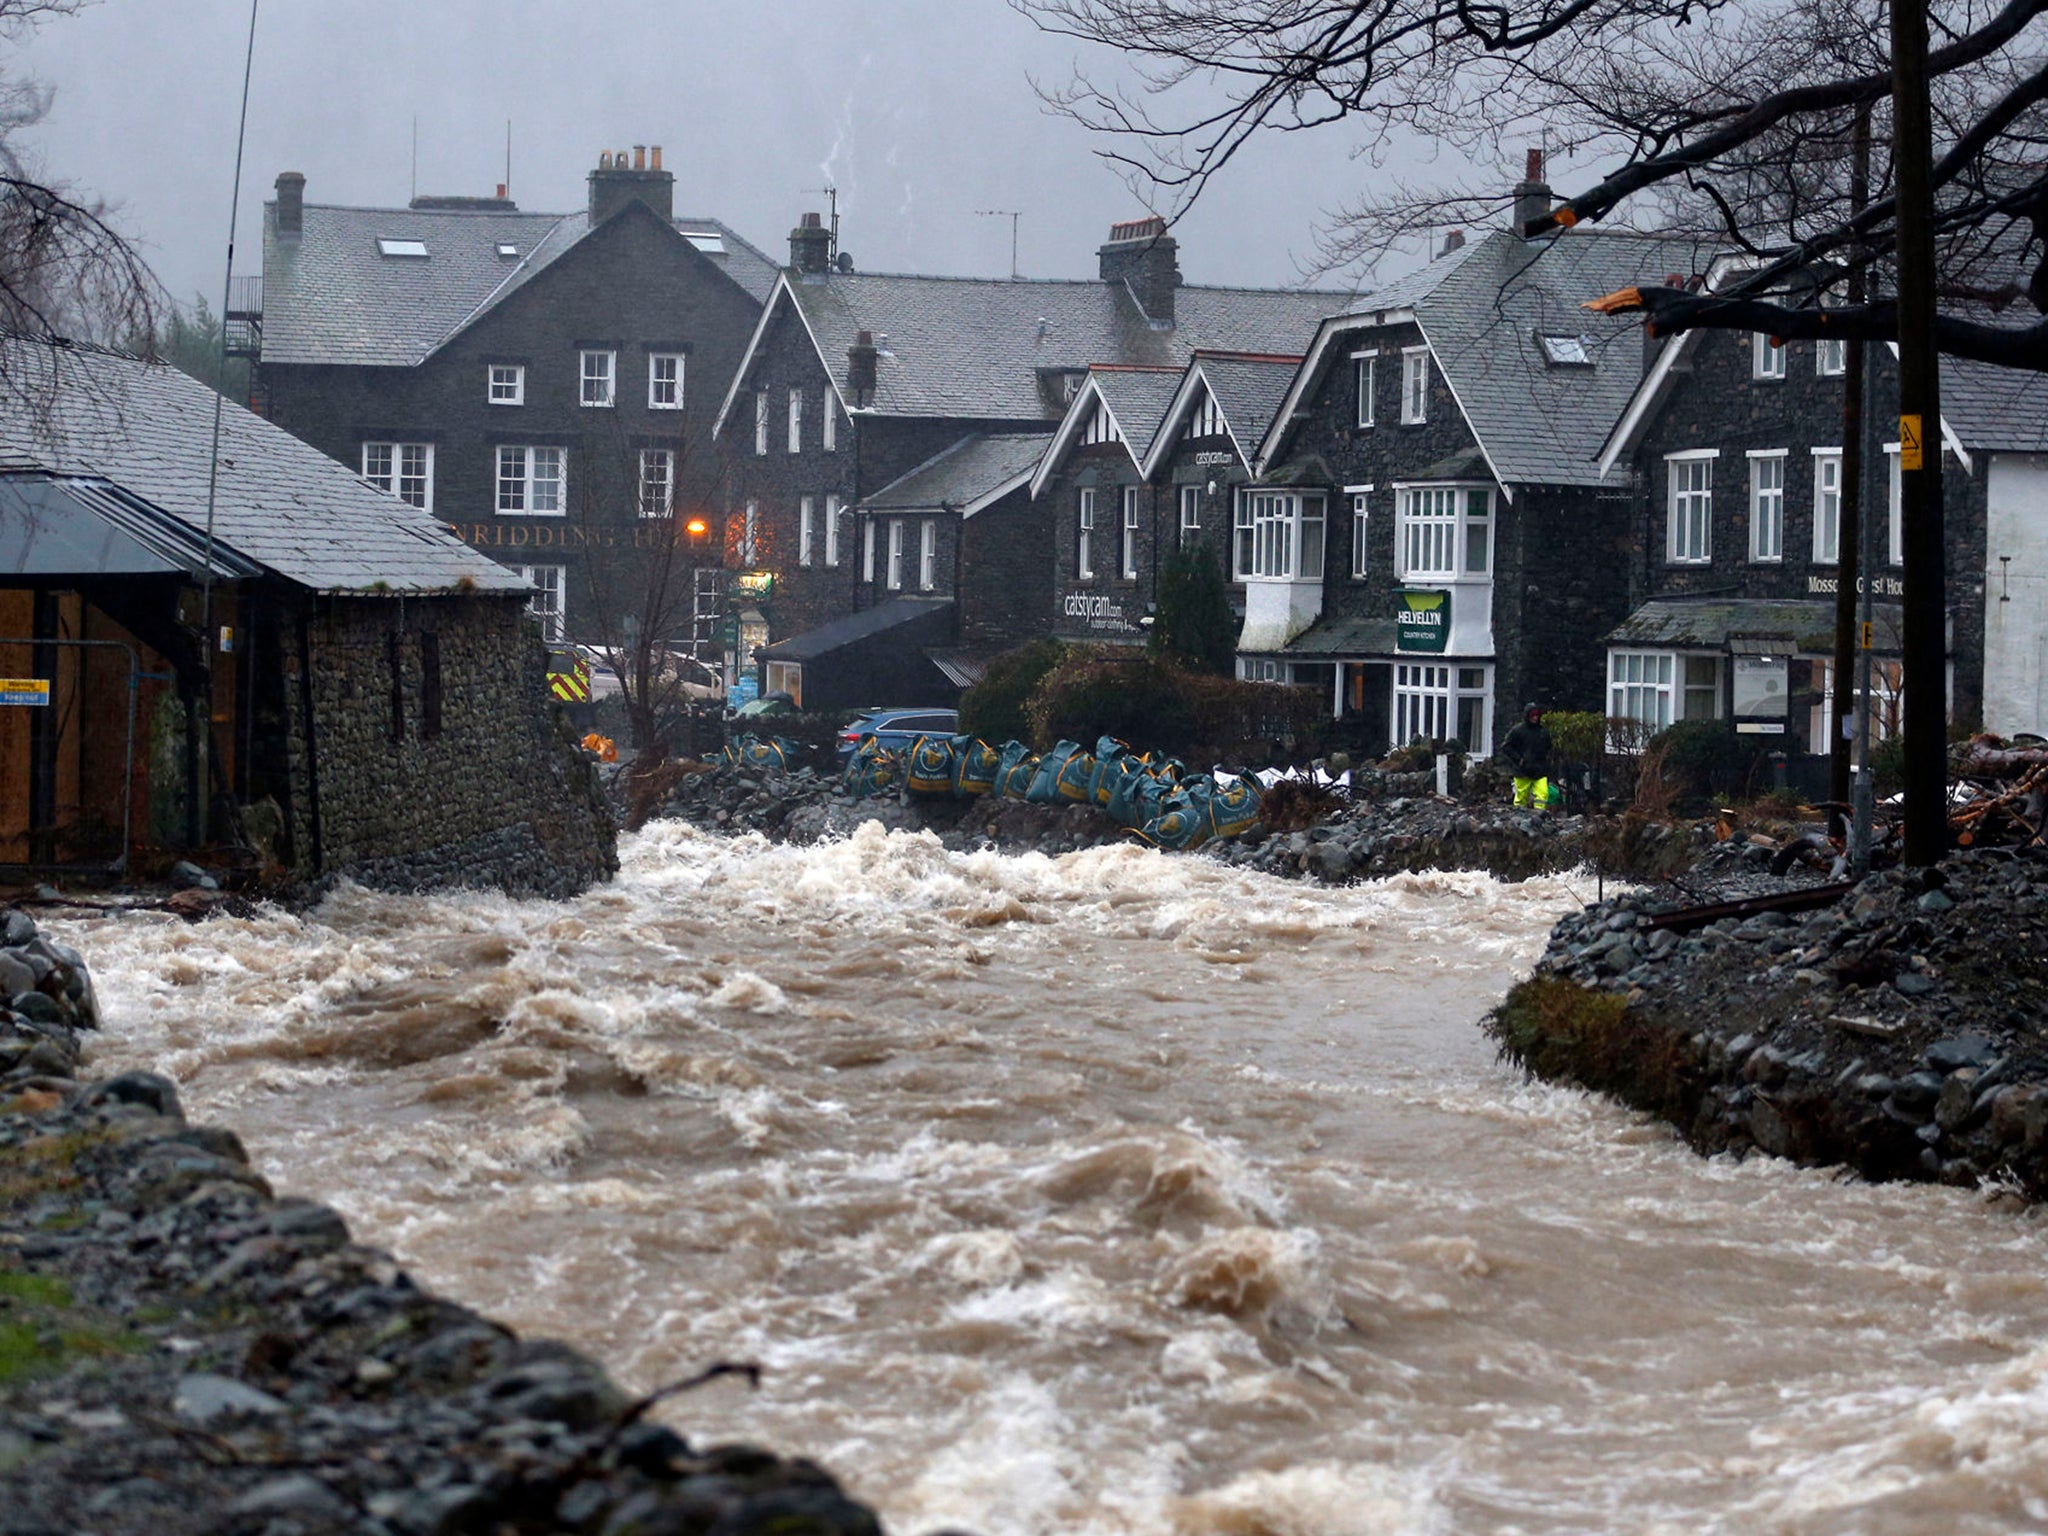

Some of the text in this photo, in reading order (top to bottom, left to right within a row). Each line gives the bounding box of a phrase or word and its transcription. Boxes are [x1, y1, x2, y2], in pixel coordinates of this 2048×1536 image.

[449, 522, 617, 548] NRIDDING
[1808, 576, 1839, 593] Mossc
[1064, 590, 1122, 623] catstycam.com
[1398, 611, 1441, 625] HELVELLYN
